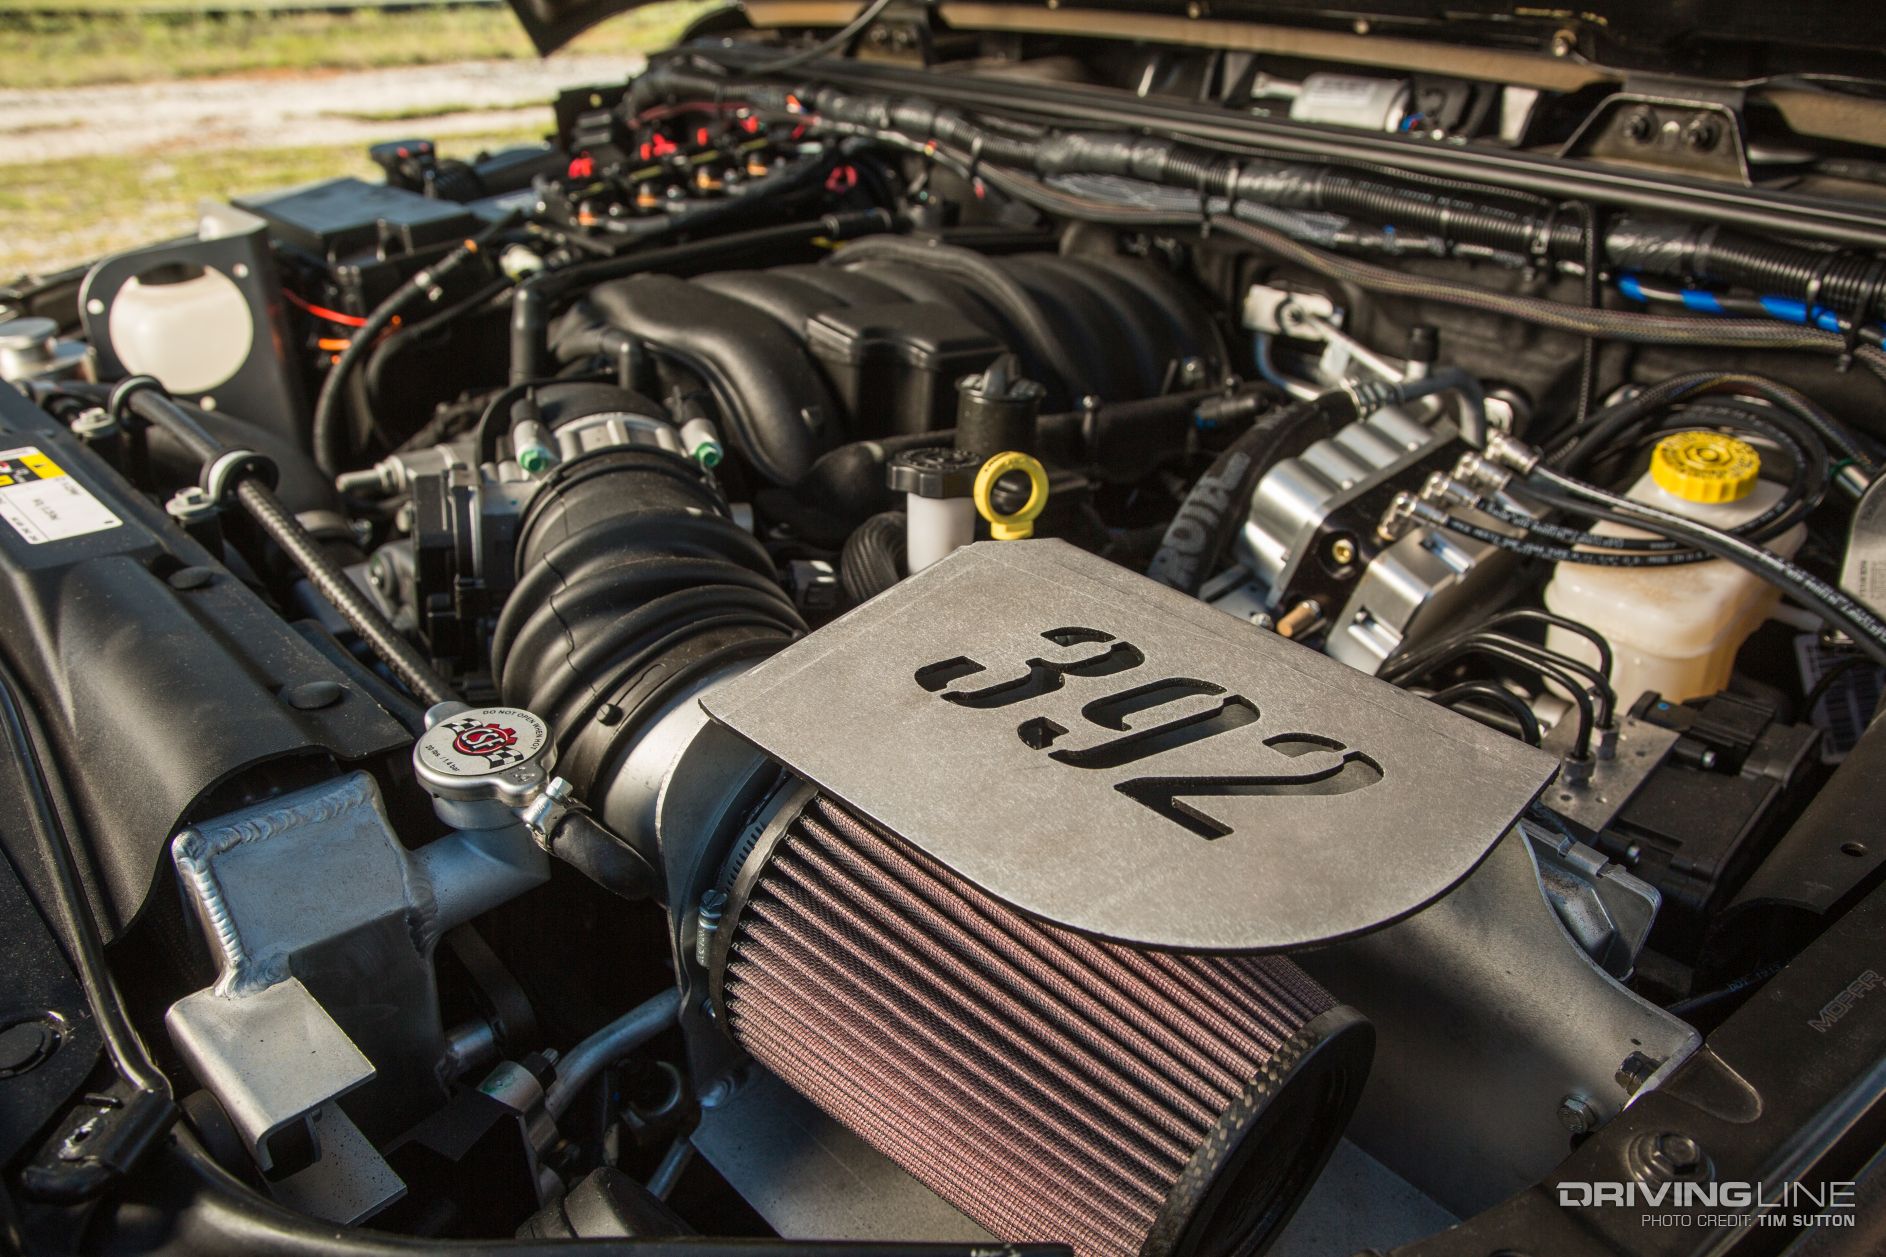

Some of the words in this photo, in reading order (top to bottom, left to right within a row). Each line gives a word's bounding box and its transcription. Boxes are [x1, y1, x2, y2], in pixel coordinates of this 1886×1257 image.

[517, 713, 536, 723] OPEN
[532, 722, 544, 738] WHEN
[461, 728, 506, 750] CSF
[530, 738, 542, 750] HOT
[1807, 969, 1884, 1033] MOPAR
